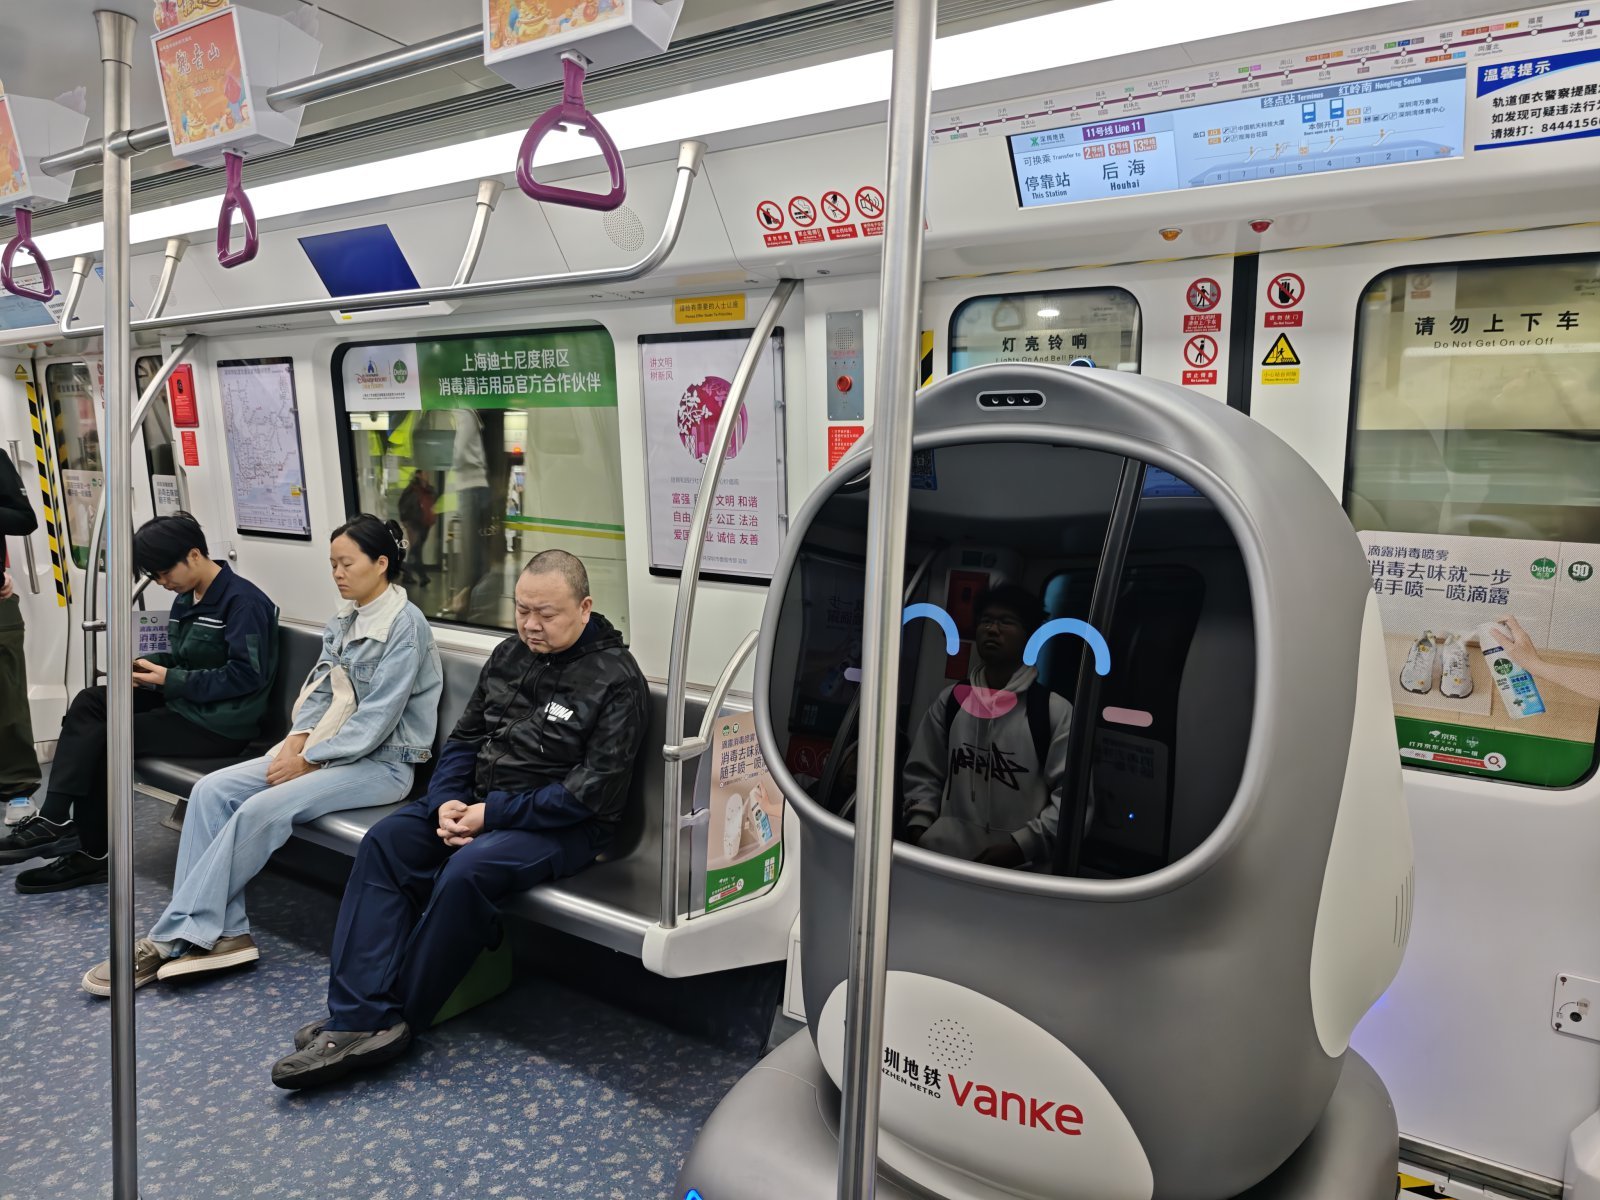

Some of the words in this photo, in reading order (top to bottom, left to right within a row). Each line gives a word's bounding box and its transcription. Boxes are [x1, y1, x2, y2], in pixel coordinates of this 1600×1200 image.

[1483, 60, 1551, 82] 温馨提示
[1338, 82, 1372, 96] 红岭南
[1375, 80, 1402, 90] Hongling
[1404, 76, 1422, 86] South
[1492, 84, 1600, 109] 轨道便衣警察提醒
[1086, 126, 1114, 138] 11号线
[1114, 124, 1130, 134] Line
[1132, 122, 1141, 131] 11
[1308, 119, 1340, 130] 本侧开门
[1023, 154, 1051, 166] 可换乘
[1052, 152, 1074, 161] Transfer
[1102, 158, 1146, 181] 后海
[1024, 172, 1070, 192] 停靠站
[1110, 180, 1140, 191] Houhai
[1046, 190, 1068, 198] Station
[1414, 310, 1580, 336] 请勿上下车
[1002, 333, 1087, 352] 灯亮铃响
[1452, 340, 1472, 348] Not
[1476, 339, 1496, 348] Get
[1500, 338, 1516, 346] On
[1535, 337, 1554, 346] Off
[462, 348, 570, 372] 上海迪士尼度假区
[650, 357, 673, 368] 讲文明
[1050, 354, 1066, 362] Bell
[438, 372, 602, 396] 消毒清洁用品官方合作伙伴
[650, 371, 674, 382] 树新风
[672, 493, 691, 506] 富强
[716, 494, 735, 507] 文明
[738, 495, 758, 508] 和谐
[673, 511, 691, 523] 自由
[716, 514, 736, 526] 公正
[738, 514, 758, 527] 法治
[716, 532, 736, 544] 诚信
[739, 533, 759, 546] 友善
[1368, 545, 1450, 562] 滴露消毒喷雾
[1368, 560, 1512, 586] 消毒去味就一步
[1532, 564, 1556, 573] Dettol
[910, 1081, 941, 1099] METRO
[948, 1073, 1084, 1136] vanke
